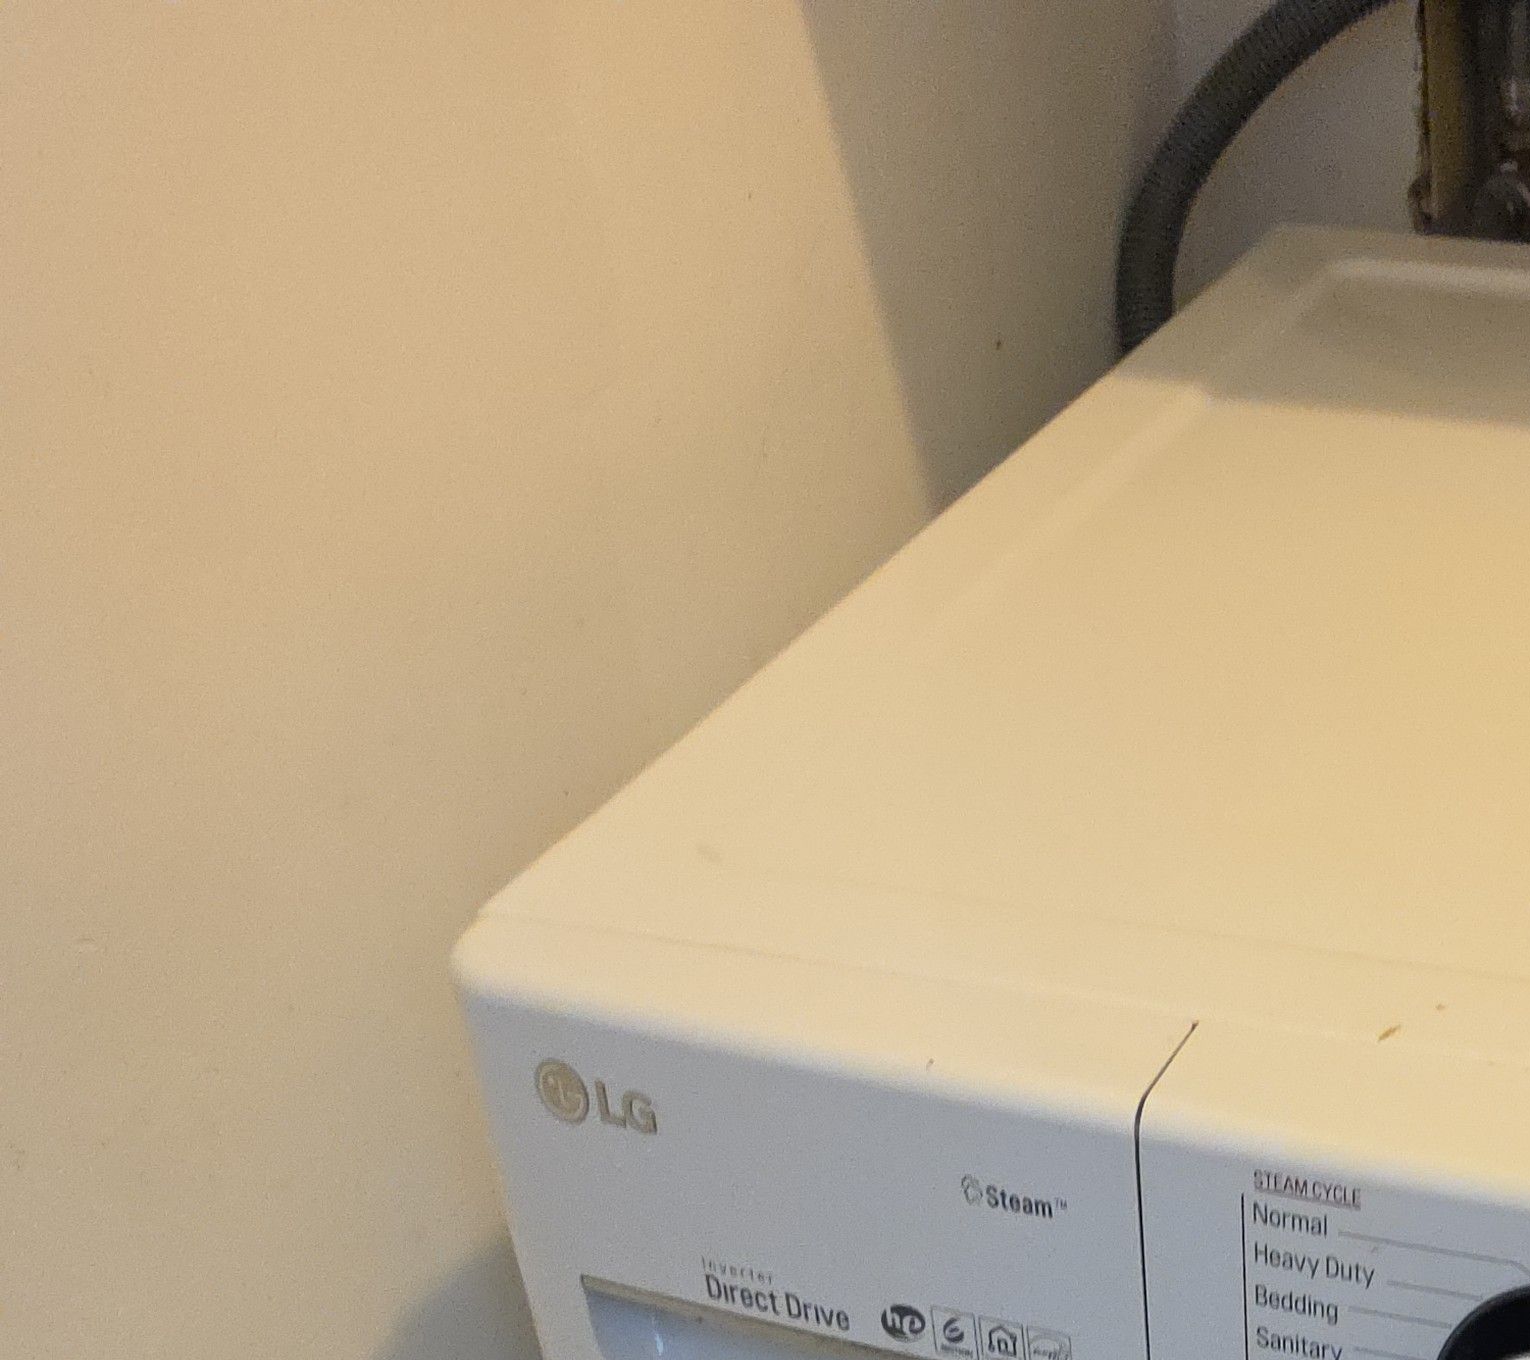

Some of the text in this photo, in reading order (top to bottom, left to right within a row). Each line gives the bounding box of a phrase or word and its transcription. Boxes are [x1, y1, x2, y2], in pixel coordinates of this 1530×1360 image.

[595, 1079, 658, 1134] LG
[1253, 1168, 1361, 1208] STEAM CYCLE
[1253, 1200, 1328, 1239] Normal
[1254, 1241, 1376, 1290] Heavy Duty
[705, 1273, 851, 1332] Direct Drive
[1255, 1283, 1338, 1326] Bedding
